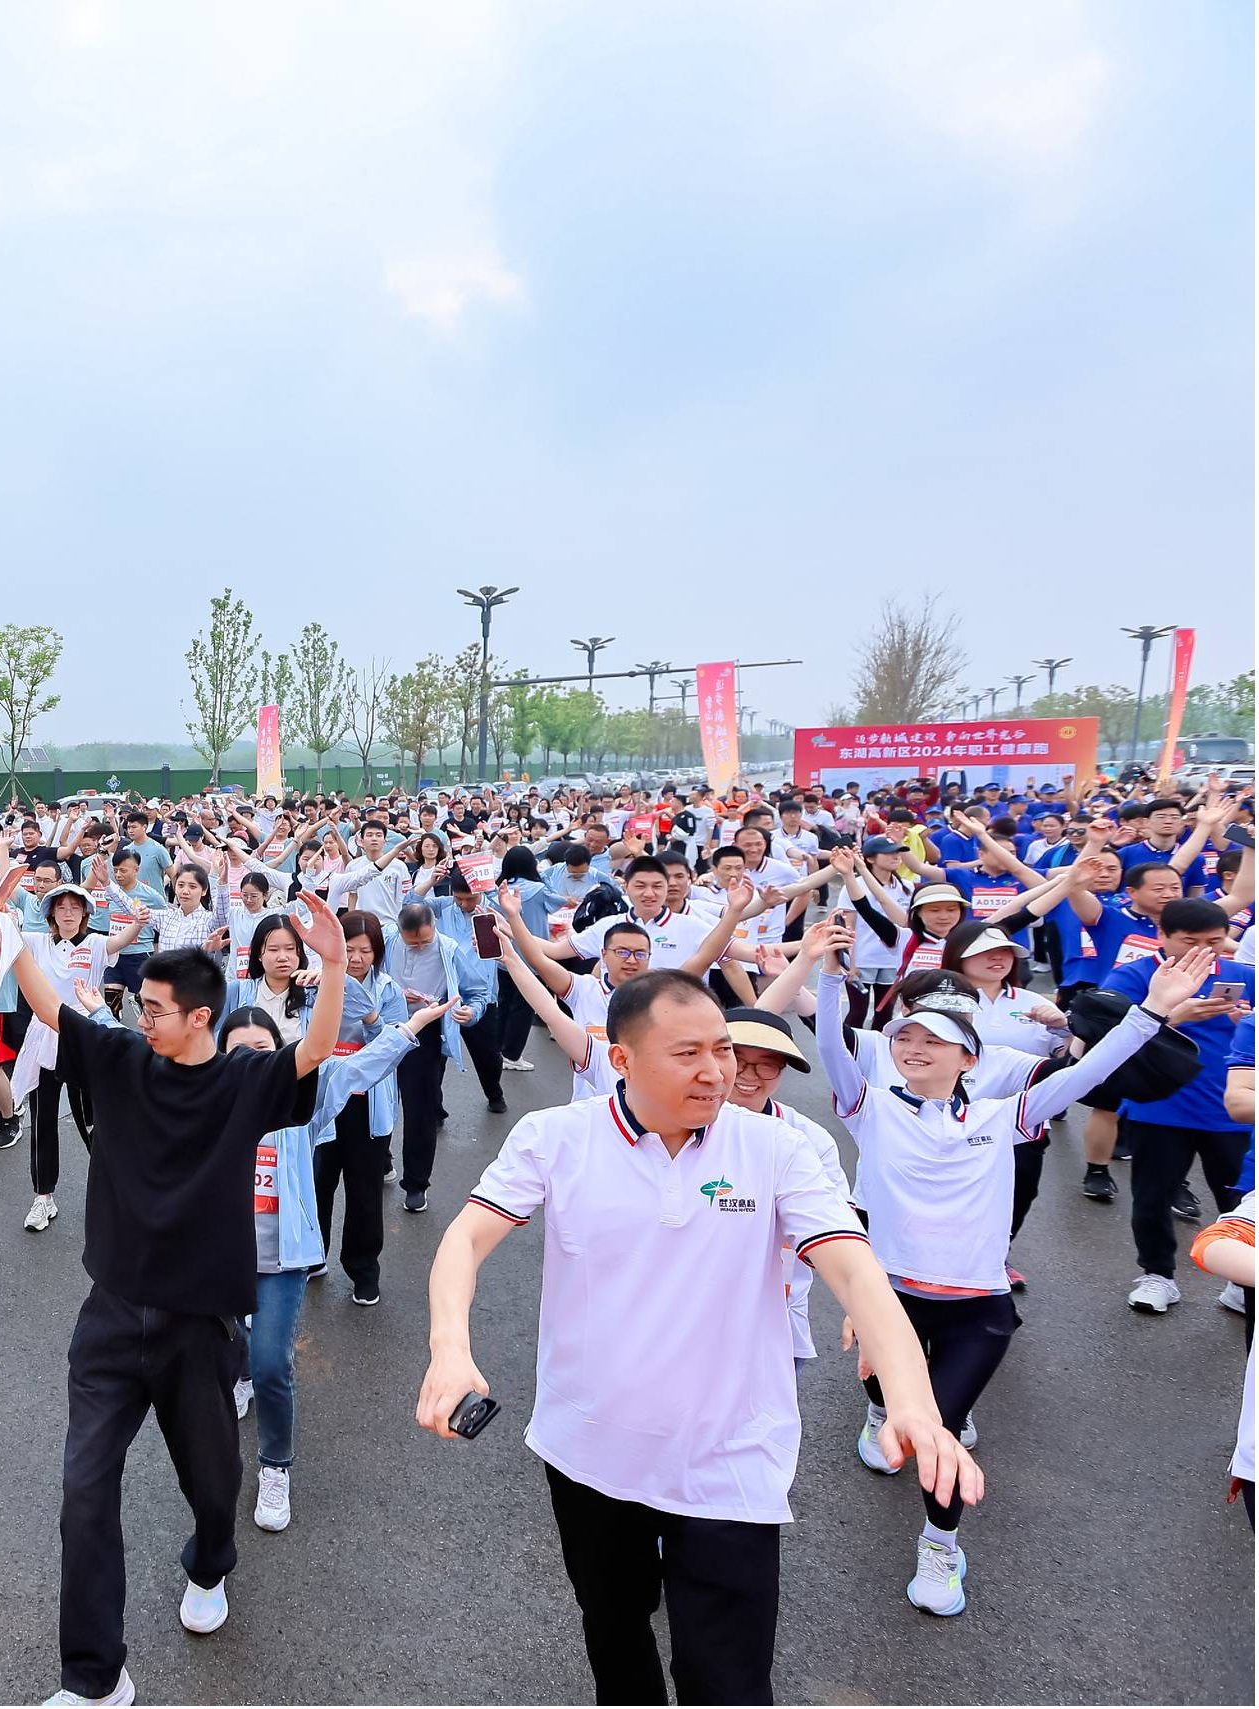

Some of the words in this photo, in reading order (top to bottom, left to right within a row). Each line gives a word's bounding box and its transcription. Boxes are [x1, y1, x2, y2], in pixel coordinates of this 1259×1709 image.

[839, 742, 1049, 760] 东湖高新区2024年职工健康跑
[718, 1198, 756, 1208] 武汉高科
